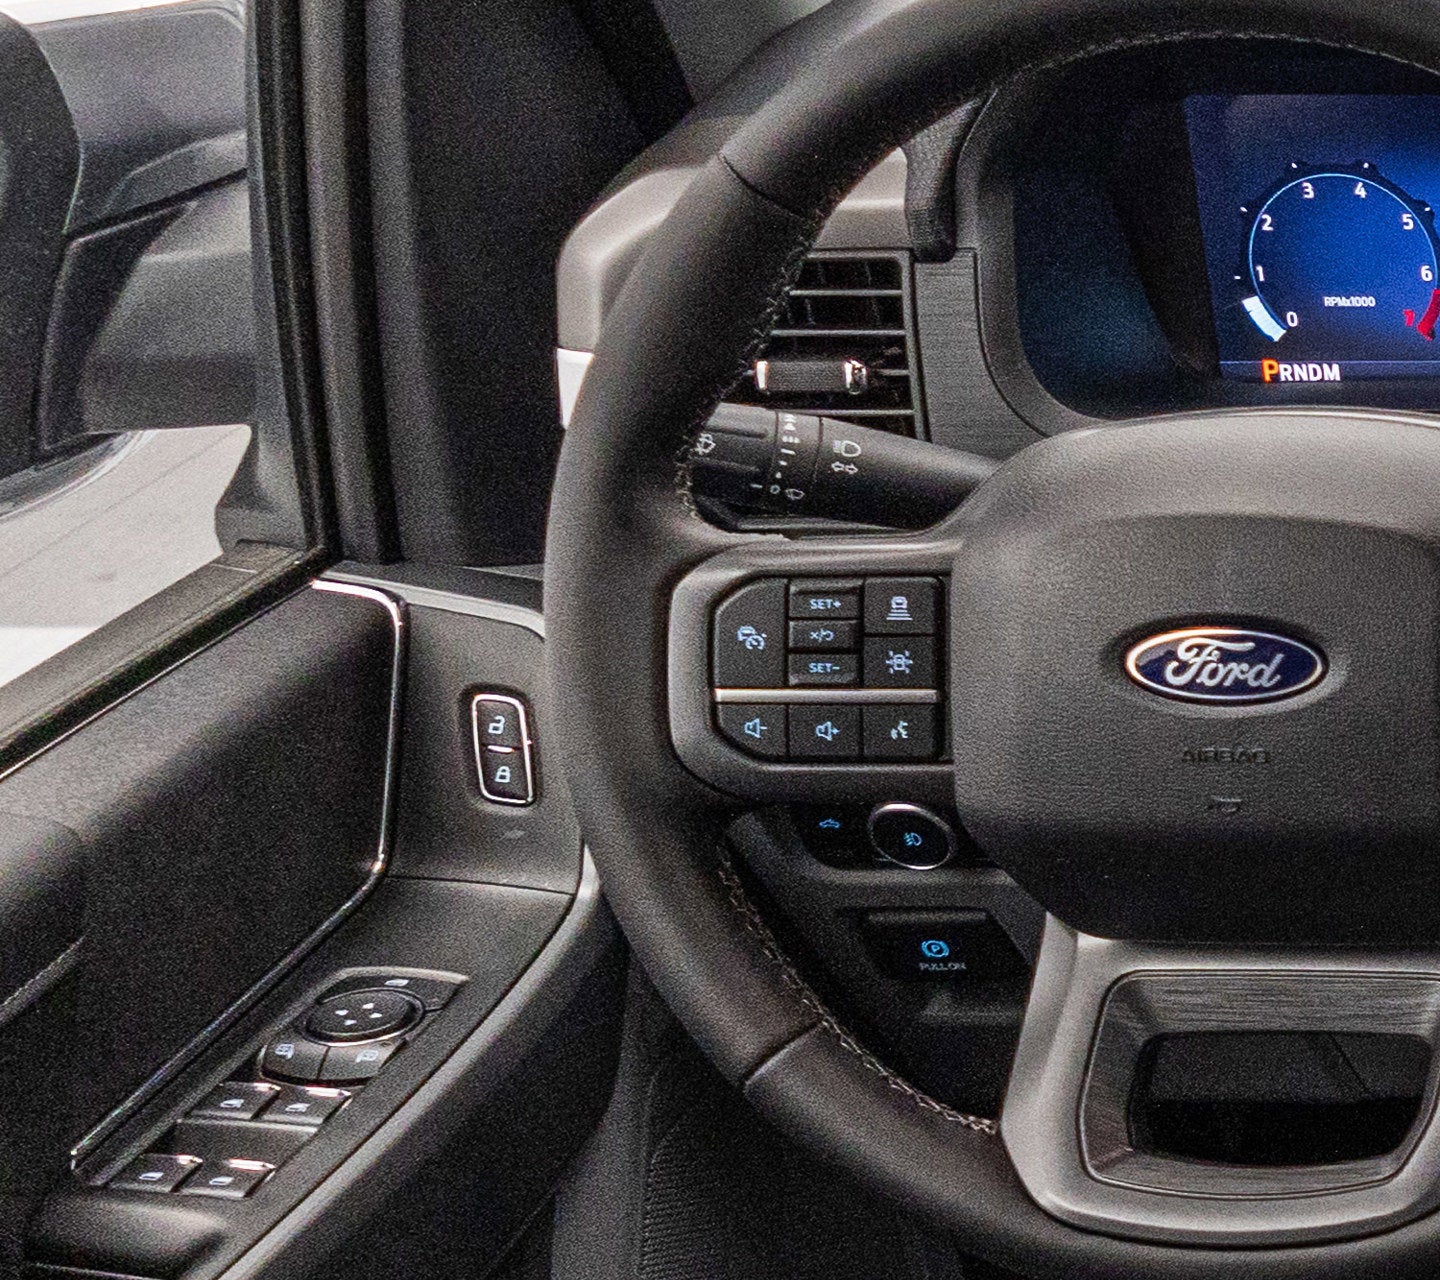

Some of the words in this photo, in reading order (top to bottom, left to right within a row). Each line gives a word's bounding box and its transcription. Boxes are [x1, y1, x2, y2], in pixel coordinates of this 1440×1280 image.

[1302, 182, 1315, 199] 3
[1354, 182, 1367, 199] 4
[1261, 215, 1274, 231] 2
[1402, 214, 1414, 230] 5
[1256, 266, 1265, 282] 1
[1420, 265, 1433, 282] 6
[1286, 312, 1298, 328] 0
[1262, 358, 1341, 382] PRNDM
[809, 598, 841, 610] SET+
[1164, 636, 1285, 688] Ford
